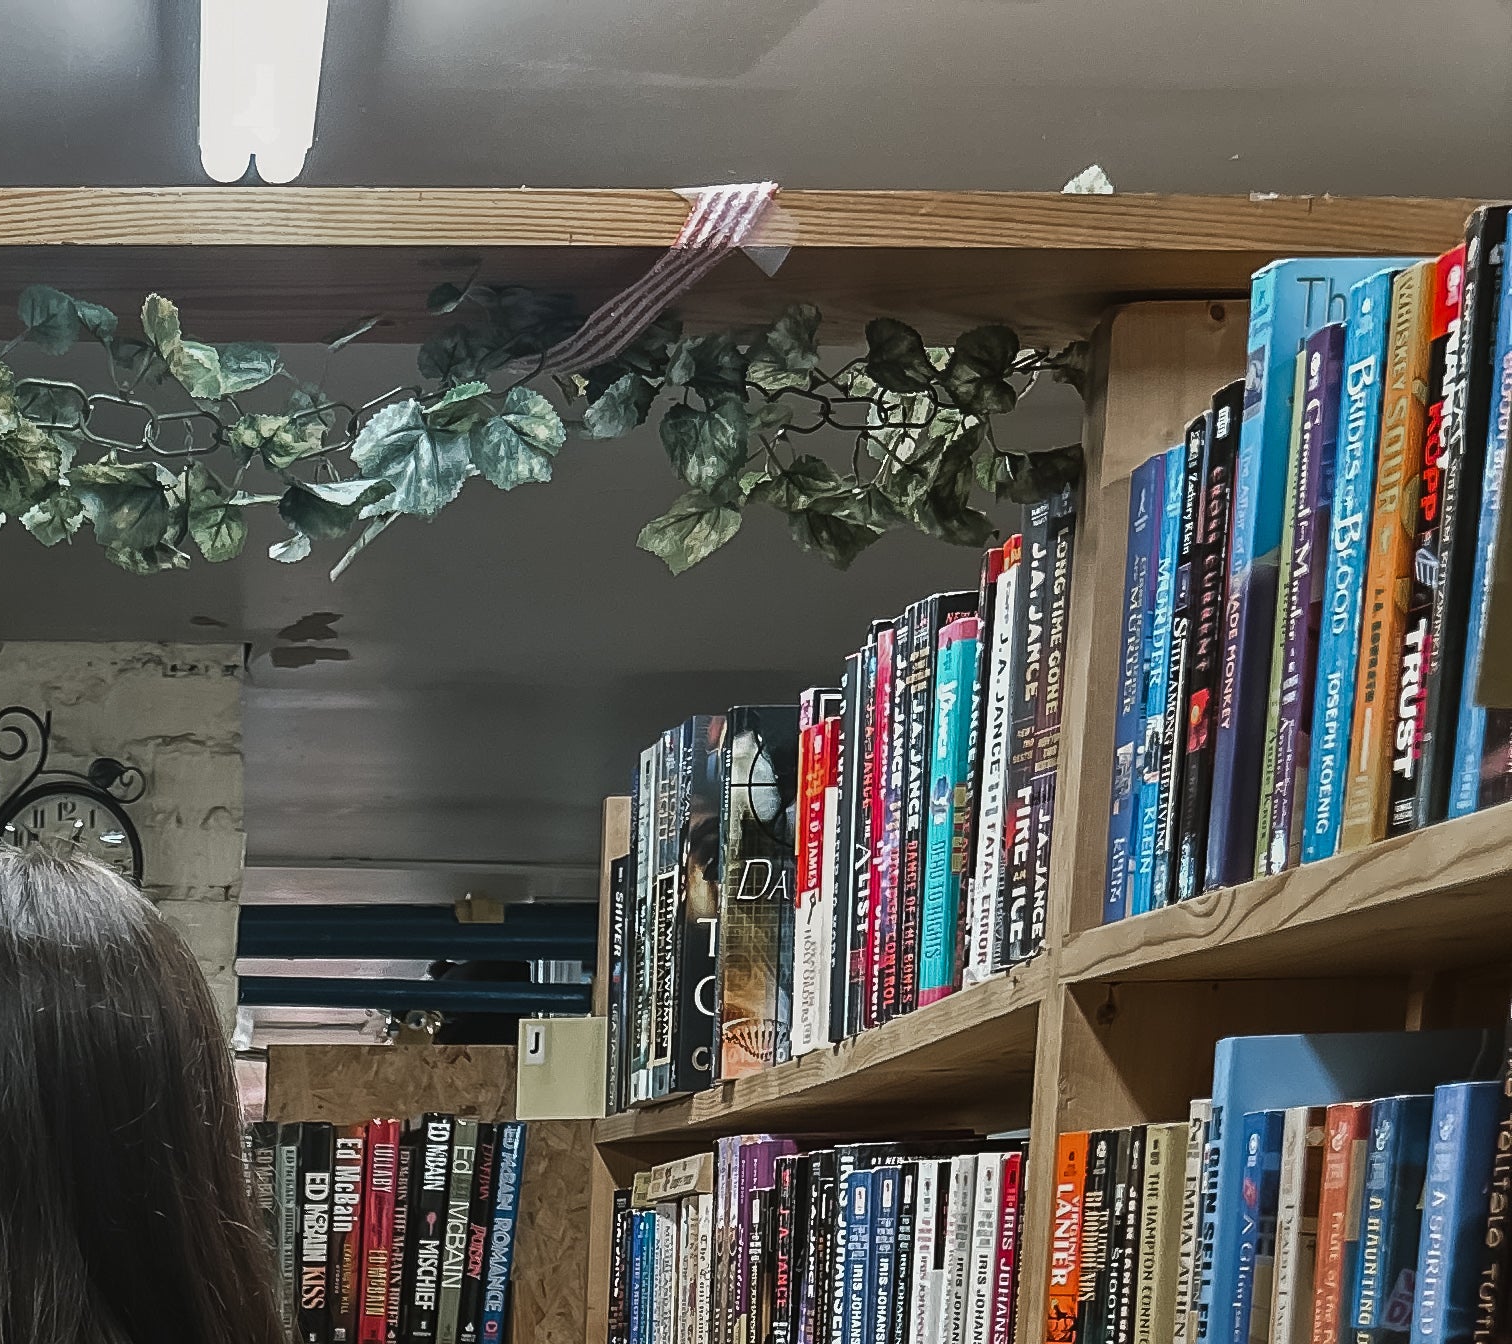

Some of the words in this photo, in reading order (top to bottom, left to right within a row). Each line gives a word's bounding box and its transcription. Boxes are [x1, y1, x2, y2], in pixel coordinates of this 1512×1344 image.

[1344, 355, 1376, 479] BRIDES
[1437, 319, 1461, 470] NANCY
[1029, 543, 1048, 599] J.A.
[1052, 527, 1069, 589] LONG
[1332, 512, 1364, 634] BLOOD
[1049, 591, 1066, 647] TIME
[1149, 558, 1171, 687] MURDER
[1170, 618, 1188, 676] STILL
[1025, 606, 1043, 702] JANCE
[1045, 651, 1063, 716] GONE
[1163, 680, 1179, 745] AMONG
[1321, 672, 1341, 749] JOSEPH
[1393, 619, 1426, 778] TRUST
[1159, 749, 1174, 782] THE
[57, 801, 76, 821] 12
[1154, 784, 1170, 856] LIVING
[1315, 756, 1335, 834] KOENIG
[1013, 786, 1032, 866] FIRE
[1036, 809, 1051, 857] J.A.
[1140, 807, 1156, 873] KLEIN
[928, 840, 946, 878] DEAD
[928, 881, 944, 900] TO
[1009, 886, 1029, 944] ICE
[1031, 861, 1047, 940] JANCE
[612, 891, 625, 958] SHIVER
[924, 904, 944, 960] RIGHTS
[335, 1139, 363, 1158] Ed
[428, 1122, 450, 1140] ED
[452, 1146, 475, 1173] Ed
[305, 1172, 329, 1200] ED
[372, 1144, 394, 1193] LULLABY
[423, 1144, 448, 1190] McBAIN
[333, 1166, 360, 1232] McBain
[303, 1204, 328, 1261] McBAIN
[368, 1250, 387, 1263] ED
[442, 1201, 469, 1288] McBAIN
[467, 1223, 487, 1280] POISON
[1000, 1207, 1017, 1251] IRIS
[1051, 1183, 1073, 1284] LANIER
[1066, 1195, 1079, 1271] VIRGINIA
[302, 1266, 326, 1309] KISS
[366, 1266, 386, 1316] McBAIN
[414, 1240, 439, 1310] MISCHIEF
[485, 1218, 513, 1312] ROMANCE
[852, 1264, 864, 1291] IRIS
